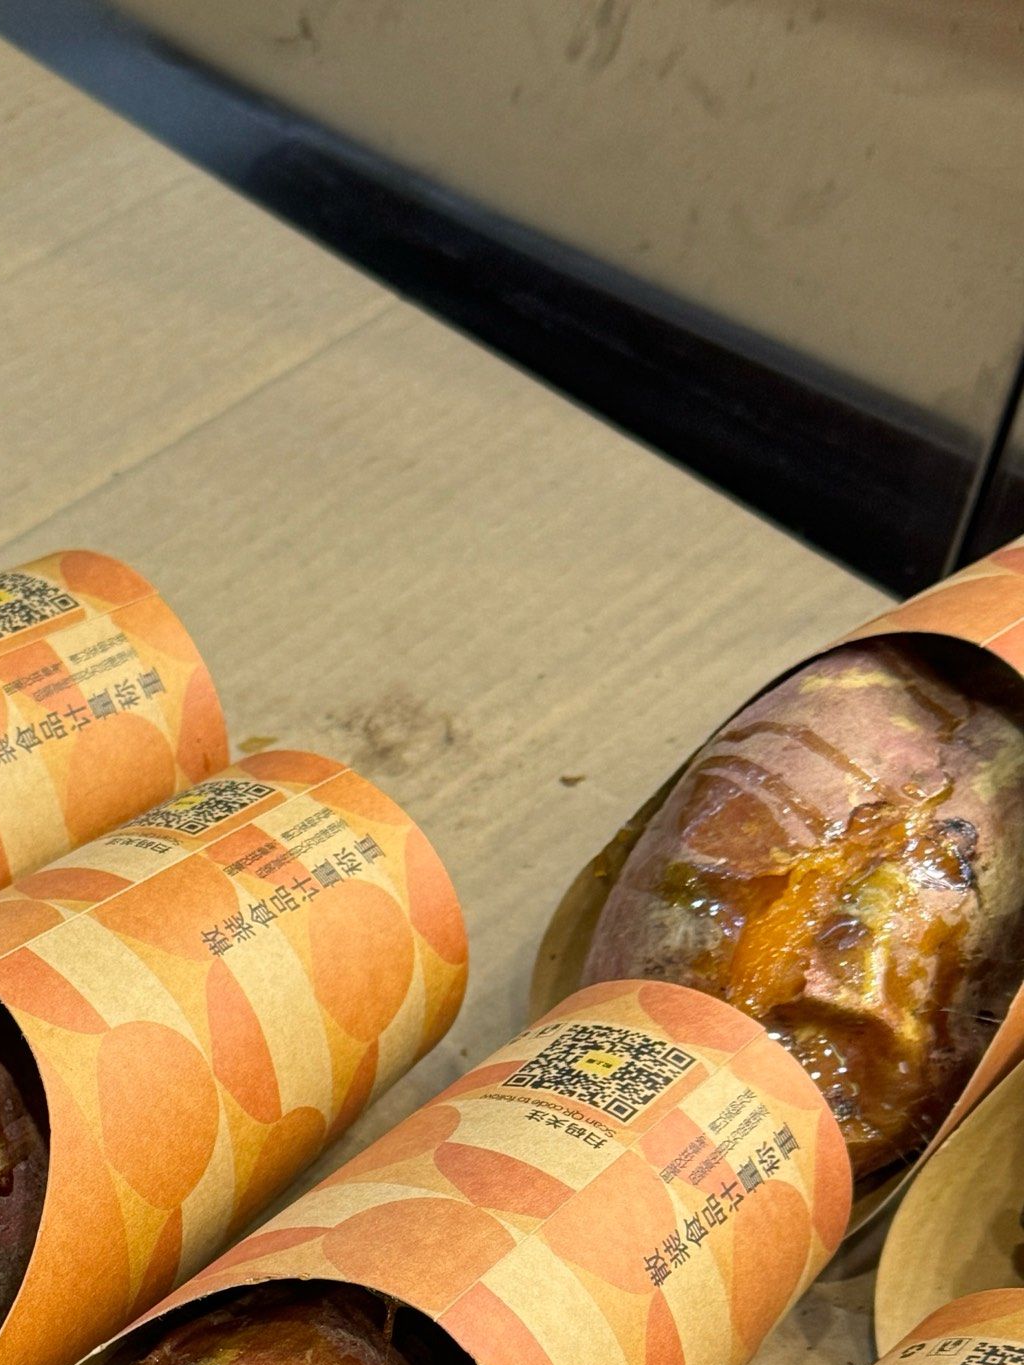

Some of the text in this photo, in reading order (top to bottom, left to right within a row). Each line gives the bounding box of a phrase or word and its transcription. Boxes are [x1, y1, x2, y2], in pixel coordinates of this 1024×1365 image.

[200, 832, 386, 958] 散装食品计量称重
[517, 1096, 531, 1105] to
[531, 1099, 562, 1112] code
[563, 1108, 585, 1121] QR
[524, 1108, 608, 1149] 扫码关注
[585, 1115, 618, 1139] Scan
[643, 1121, 801, 1288] 散装食品计量称重
